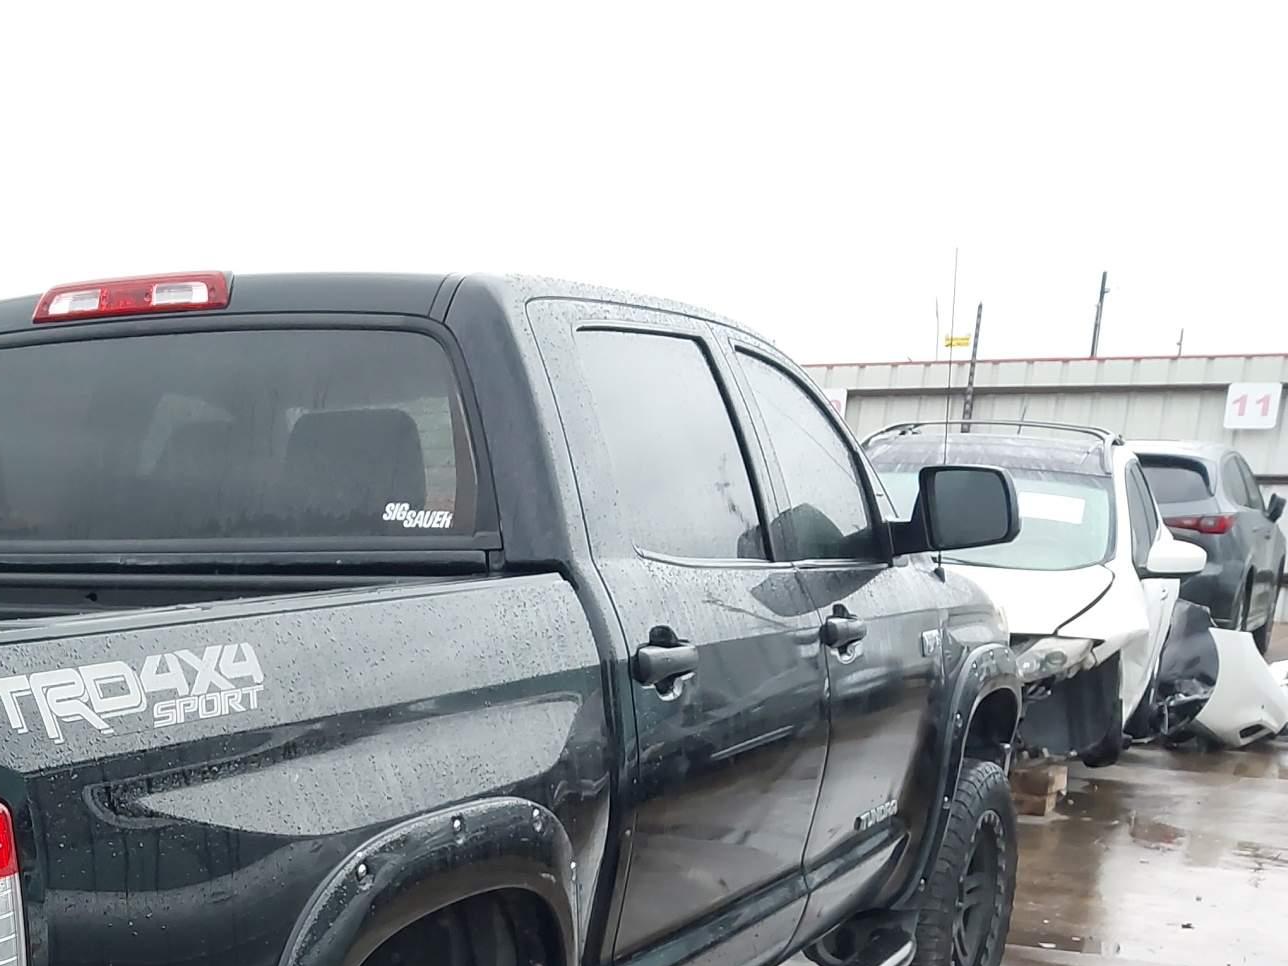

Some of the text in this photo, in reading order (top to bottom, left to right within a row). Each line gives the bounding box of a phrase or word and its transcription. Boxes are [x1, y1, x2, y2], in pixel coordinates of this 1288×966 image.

[1232, 394, 1271, 417] 11
[383, 502, 410, 521] SIG
[403, 510, 454, 528] SAUER
[153, 685, 265, 728] SPORT
[858, 799, 898, 831] TUNDRA
